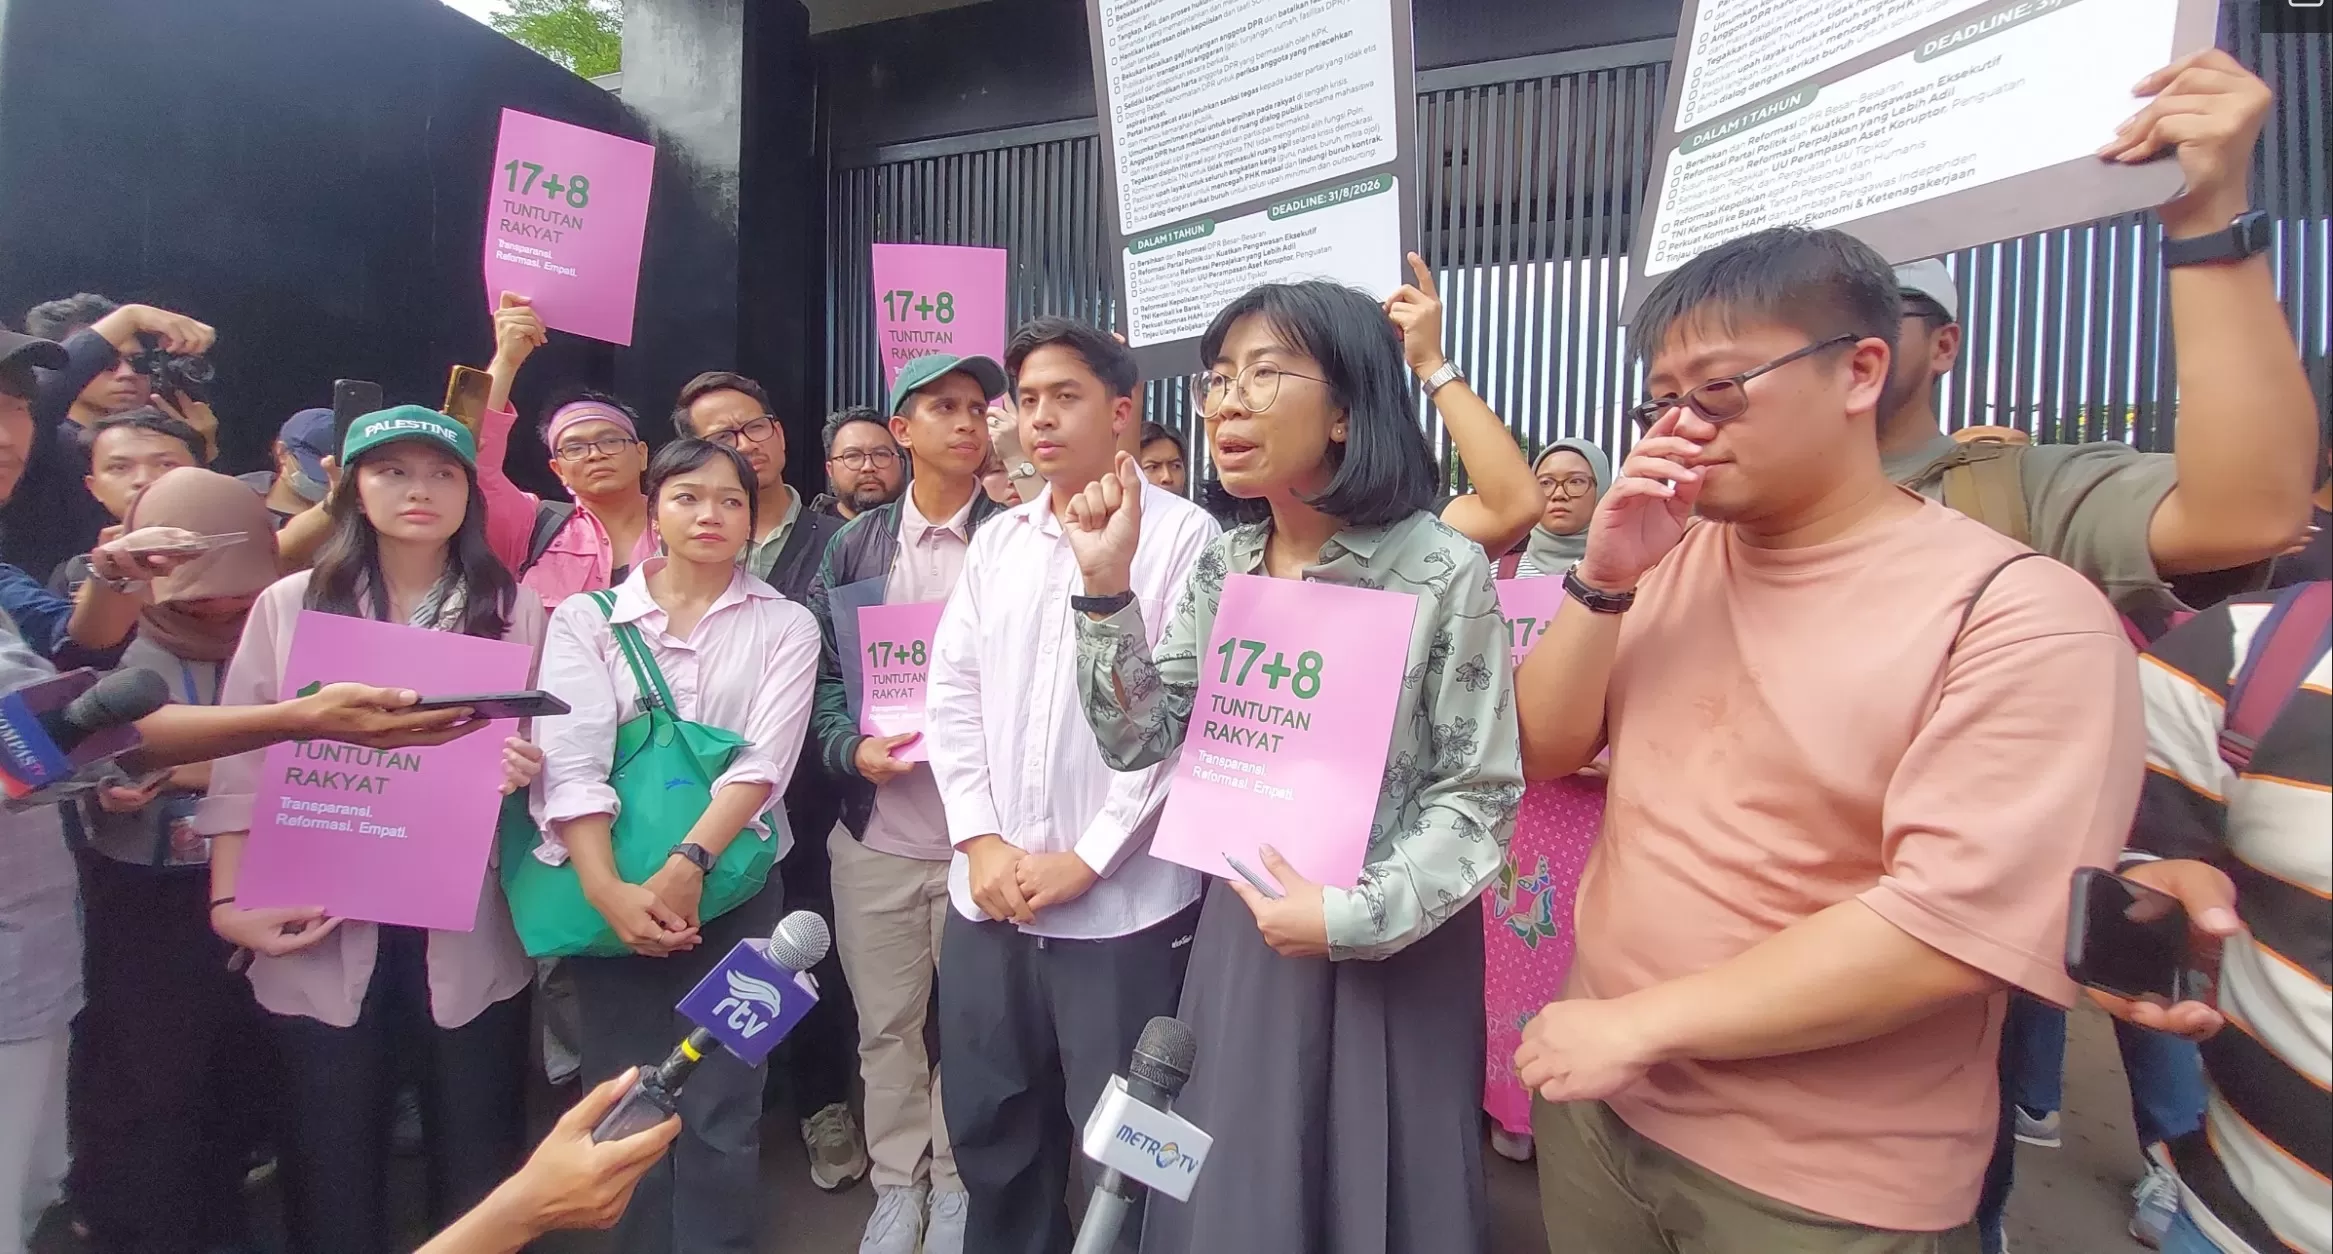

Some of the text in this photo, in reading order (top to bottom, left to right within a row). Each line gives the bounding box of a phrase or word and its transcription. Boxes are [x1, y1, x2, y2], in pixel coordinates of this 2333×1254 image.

[1170, 6, 1190, 20] proses
[1247, 17, 1263, 30] DPR
[1278, 0, 1309, 17] batalkan
[1750, 7, 1771, 24] DPR
[1819, 12, 1859, 35] seluruh
[1826, 13, 1884, 44] mencegah
[1260, 54, 1288, 69] anggota
[1289, 47, 1307, 60] yang
[1719, 39, 1854, 103] dialog dengan serikat buruh
[1240, 87, 1258, 97] tegas
[1256, 103, 1273, 116] pada
[1274, 95, 1295, 108] rakyat
[1154, 148, 1167, 158] DPR
[1259, 112, 1280, 123] dialog
[1281, 103, 1303, 118] publik
[1683, 55, 2001, 181] Reformasi Partai Politik Kuatkan Pengawasan Eksekutif
[1693, 93, 1801, 146] DALAM 1 TAHUN
[1746, 87, 1954, 168] Reformasi Perpajakan yang Lebih Adil
[1257, 145, 1277, 156] ruang
[1685, 121, 1797, 169] Bersihkan Reformasi
[1771, 126, 1885, 172] UU Perampasan Aset
[1210, 176, 1243, 190] mencegah
[1244, 170, 1260, 180] PHK
[1298, 151, 1327, 164] lindungi
[1328, 144, 1350, 156] buruh
[1259, 156, 1276, 165] kerja
[504, 159, 590, 208] 17+8
[1272, 179, 1380, 215] DEADLINE: 31/8/2026
[1804, 203, 1852, 224] Ekonomi
[1855, 198, 1863, 208] &
[1866, 168, 1974, 204] Ketenagakerjaan
[503, 200, 584, 230] TUNTUTAN
[1166, 203, 1188, 213] dengan
[1210, 190, 1229, 201] buruh
[1673, 193, 1765, 227] Reformasi Kepolisian
[500, 219, 563, 244] RAKYAT
[1137, 224, 1204, 249] DALAM 1 TAHUN
[1668, 214, 1766, 250] Perkuat Komnas HAM
[1671, 214, 1736, 238] TNI Kembali ke
[1166, 260, 1183, 268] Partai
[1216, 246, 1241, 257] Kuatkan
[1242, 236, 1283, 250] Pengawasan
[1284, 227, 1316, 240] Eksekutif
[1180, 265, 1210, 275] Reformasi
[1246, 251, 1261, 262] yang
[1262, 247, 1281, 256] Lebih
[1282, 242, 1296, 251] Adil
[1197, 261, 1262, 281] UU Perampasan Aset
[883, 290, 955, 324] 17+8
[1187, 312, 1203, 320] HAM
[888, 330, 952, 344] TUNTUTAN
[364, 419, 458, 443] PALESTINE
[867, 640, 927, 668] 17+8
[1217, 637, 1323, 699] 17+8
[872, 672, 926, 685] TUNTUTAN
[872, 688, 914, 699] RAKYAT
[1211, 694, 1311, 731] TUNTUTAN
[1203, 721, 1284, 753] RAKYAT
[292, 740, 421, 772] TUNTUTAN
[1198, 749, 1267, 776] Transparansi.
[284, 767, 389, 795] RAKYAT
[1192, 765, 1249, 790] Reformasi.
[279, 797, 373, 817] Transparansi.
[275, 813, 408, 838] Reformasi. Empati.
[712, 997, 768, 1039] rtv
